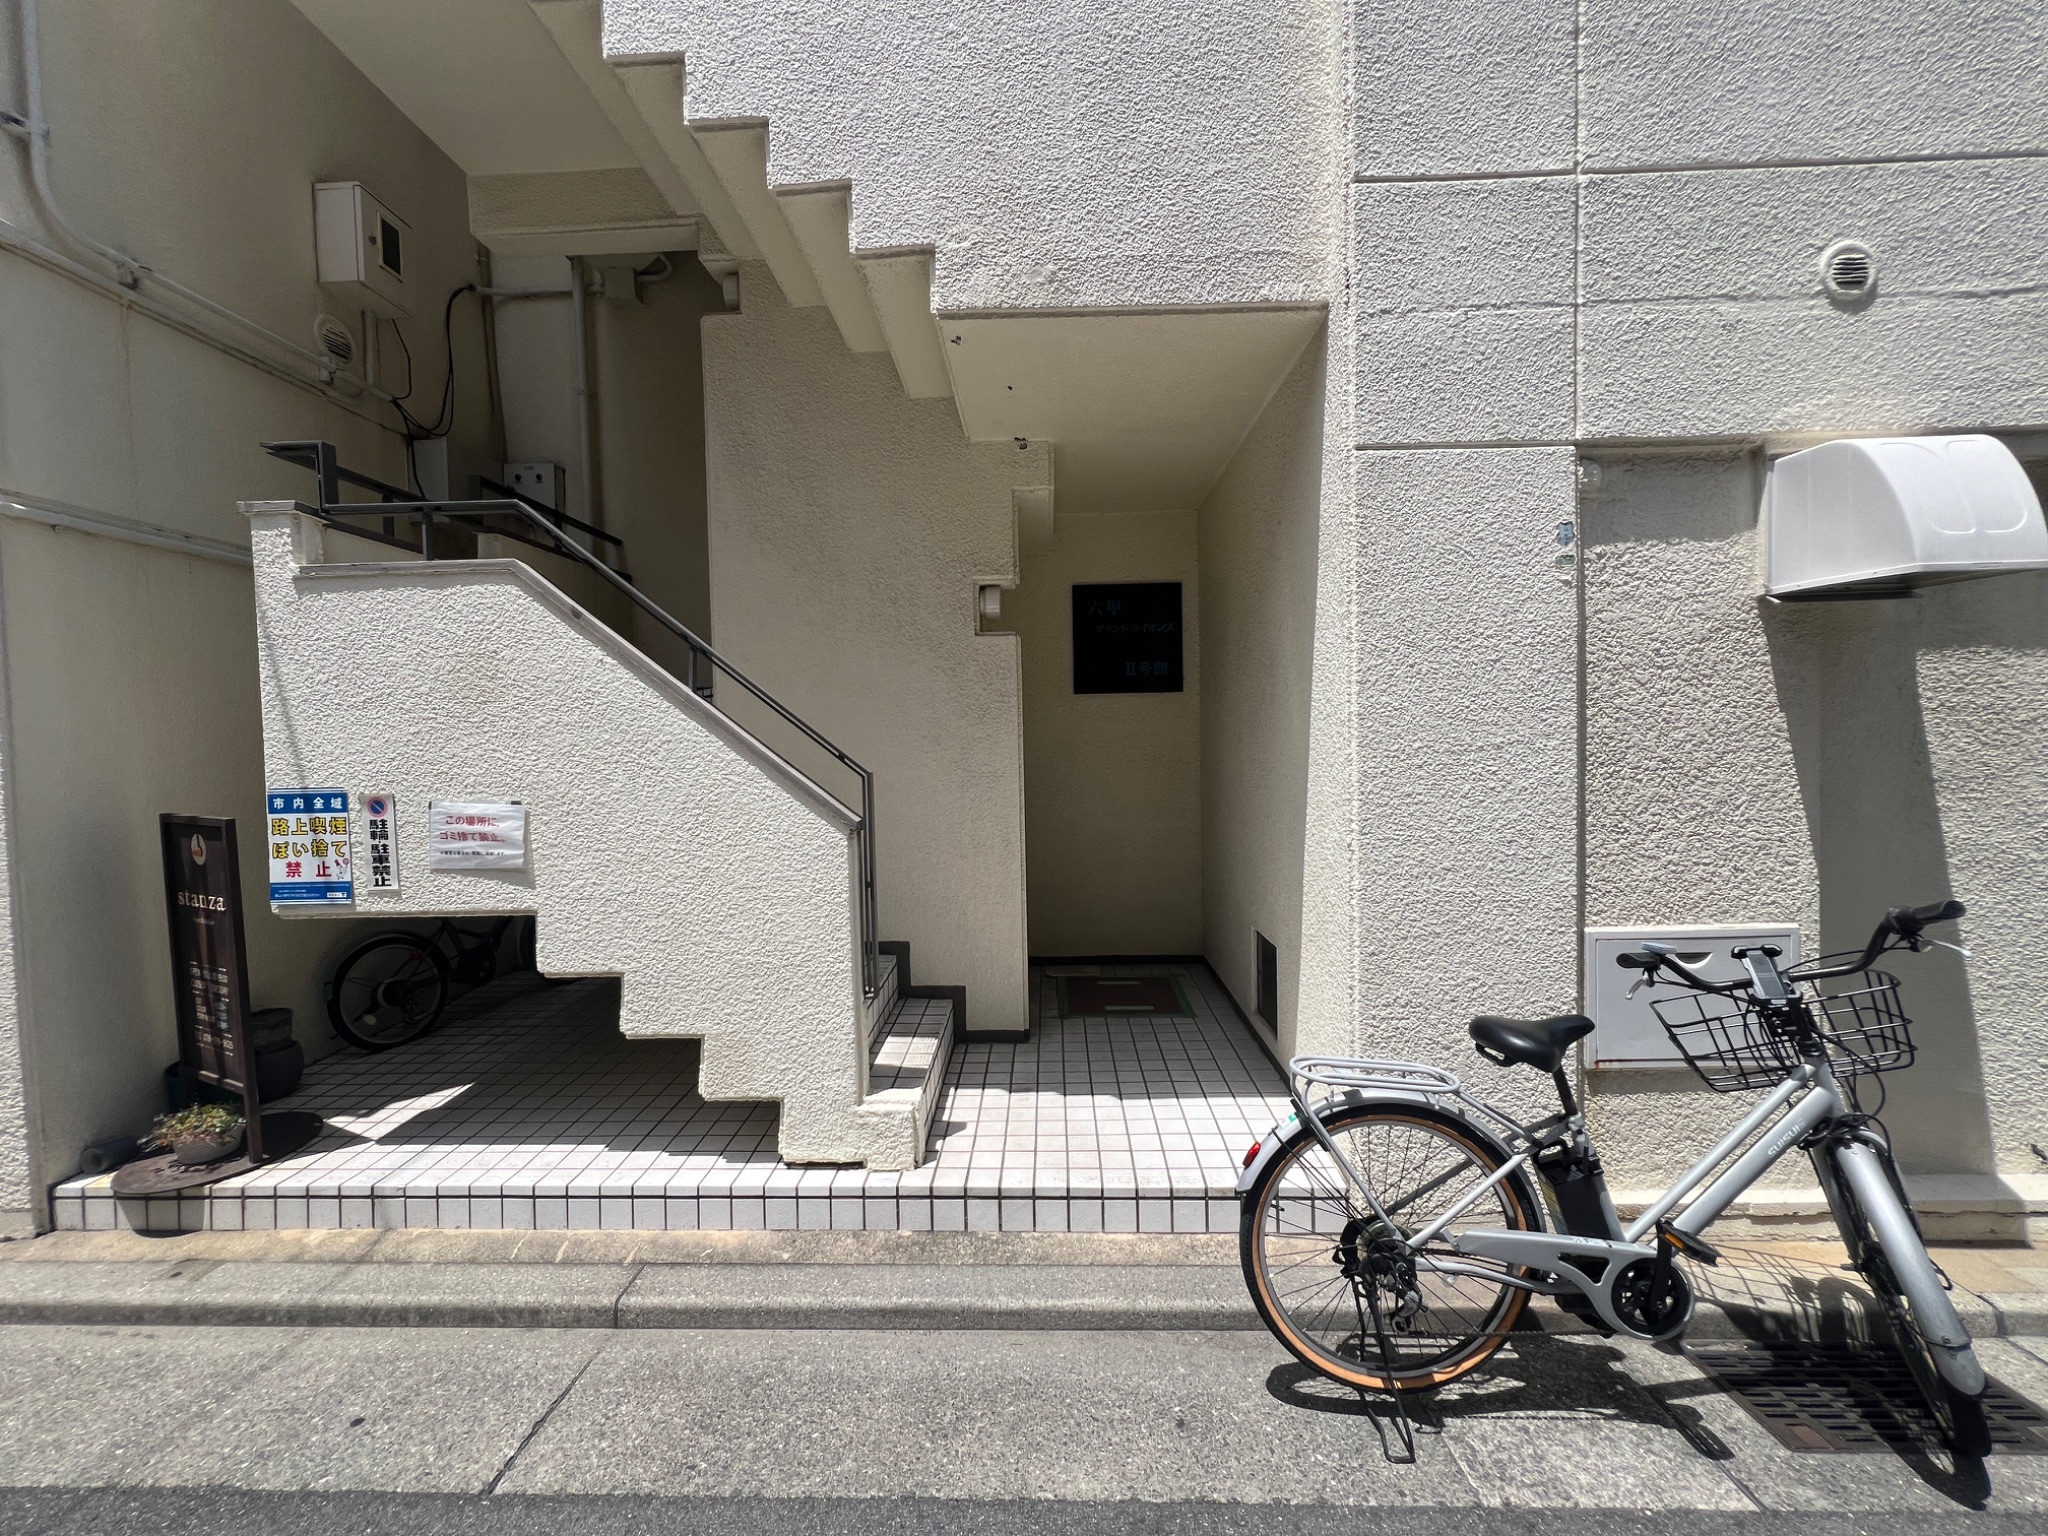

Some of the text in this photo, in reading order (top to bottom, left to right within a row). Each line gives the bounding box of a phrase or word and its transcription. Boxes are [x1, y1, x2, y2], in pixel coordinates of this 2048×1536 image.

[1087, 600, 1121, 616] 六甲
[273, 797, 343, 810] 市内全域
[271, 817, 347, 836] 路上喫煙
[272, 839, 347, 859] ぽい捨て
[285, 861, 332, 877] 禁止
[178, 889, 227, 911] stanza
